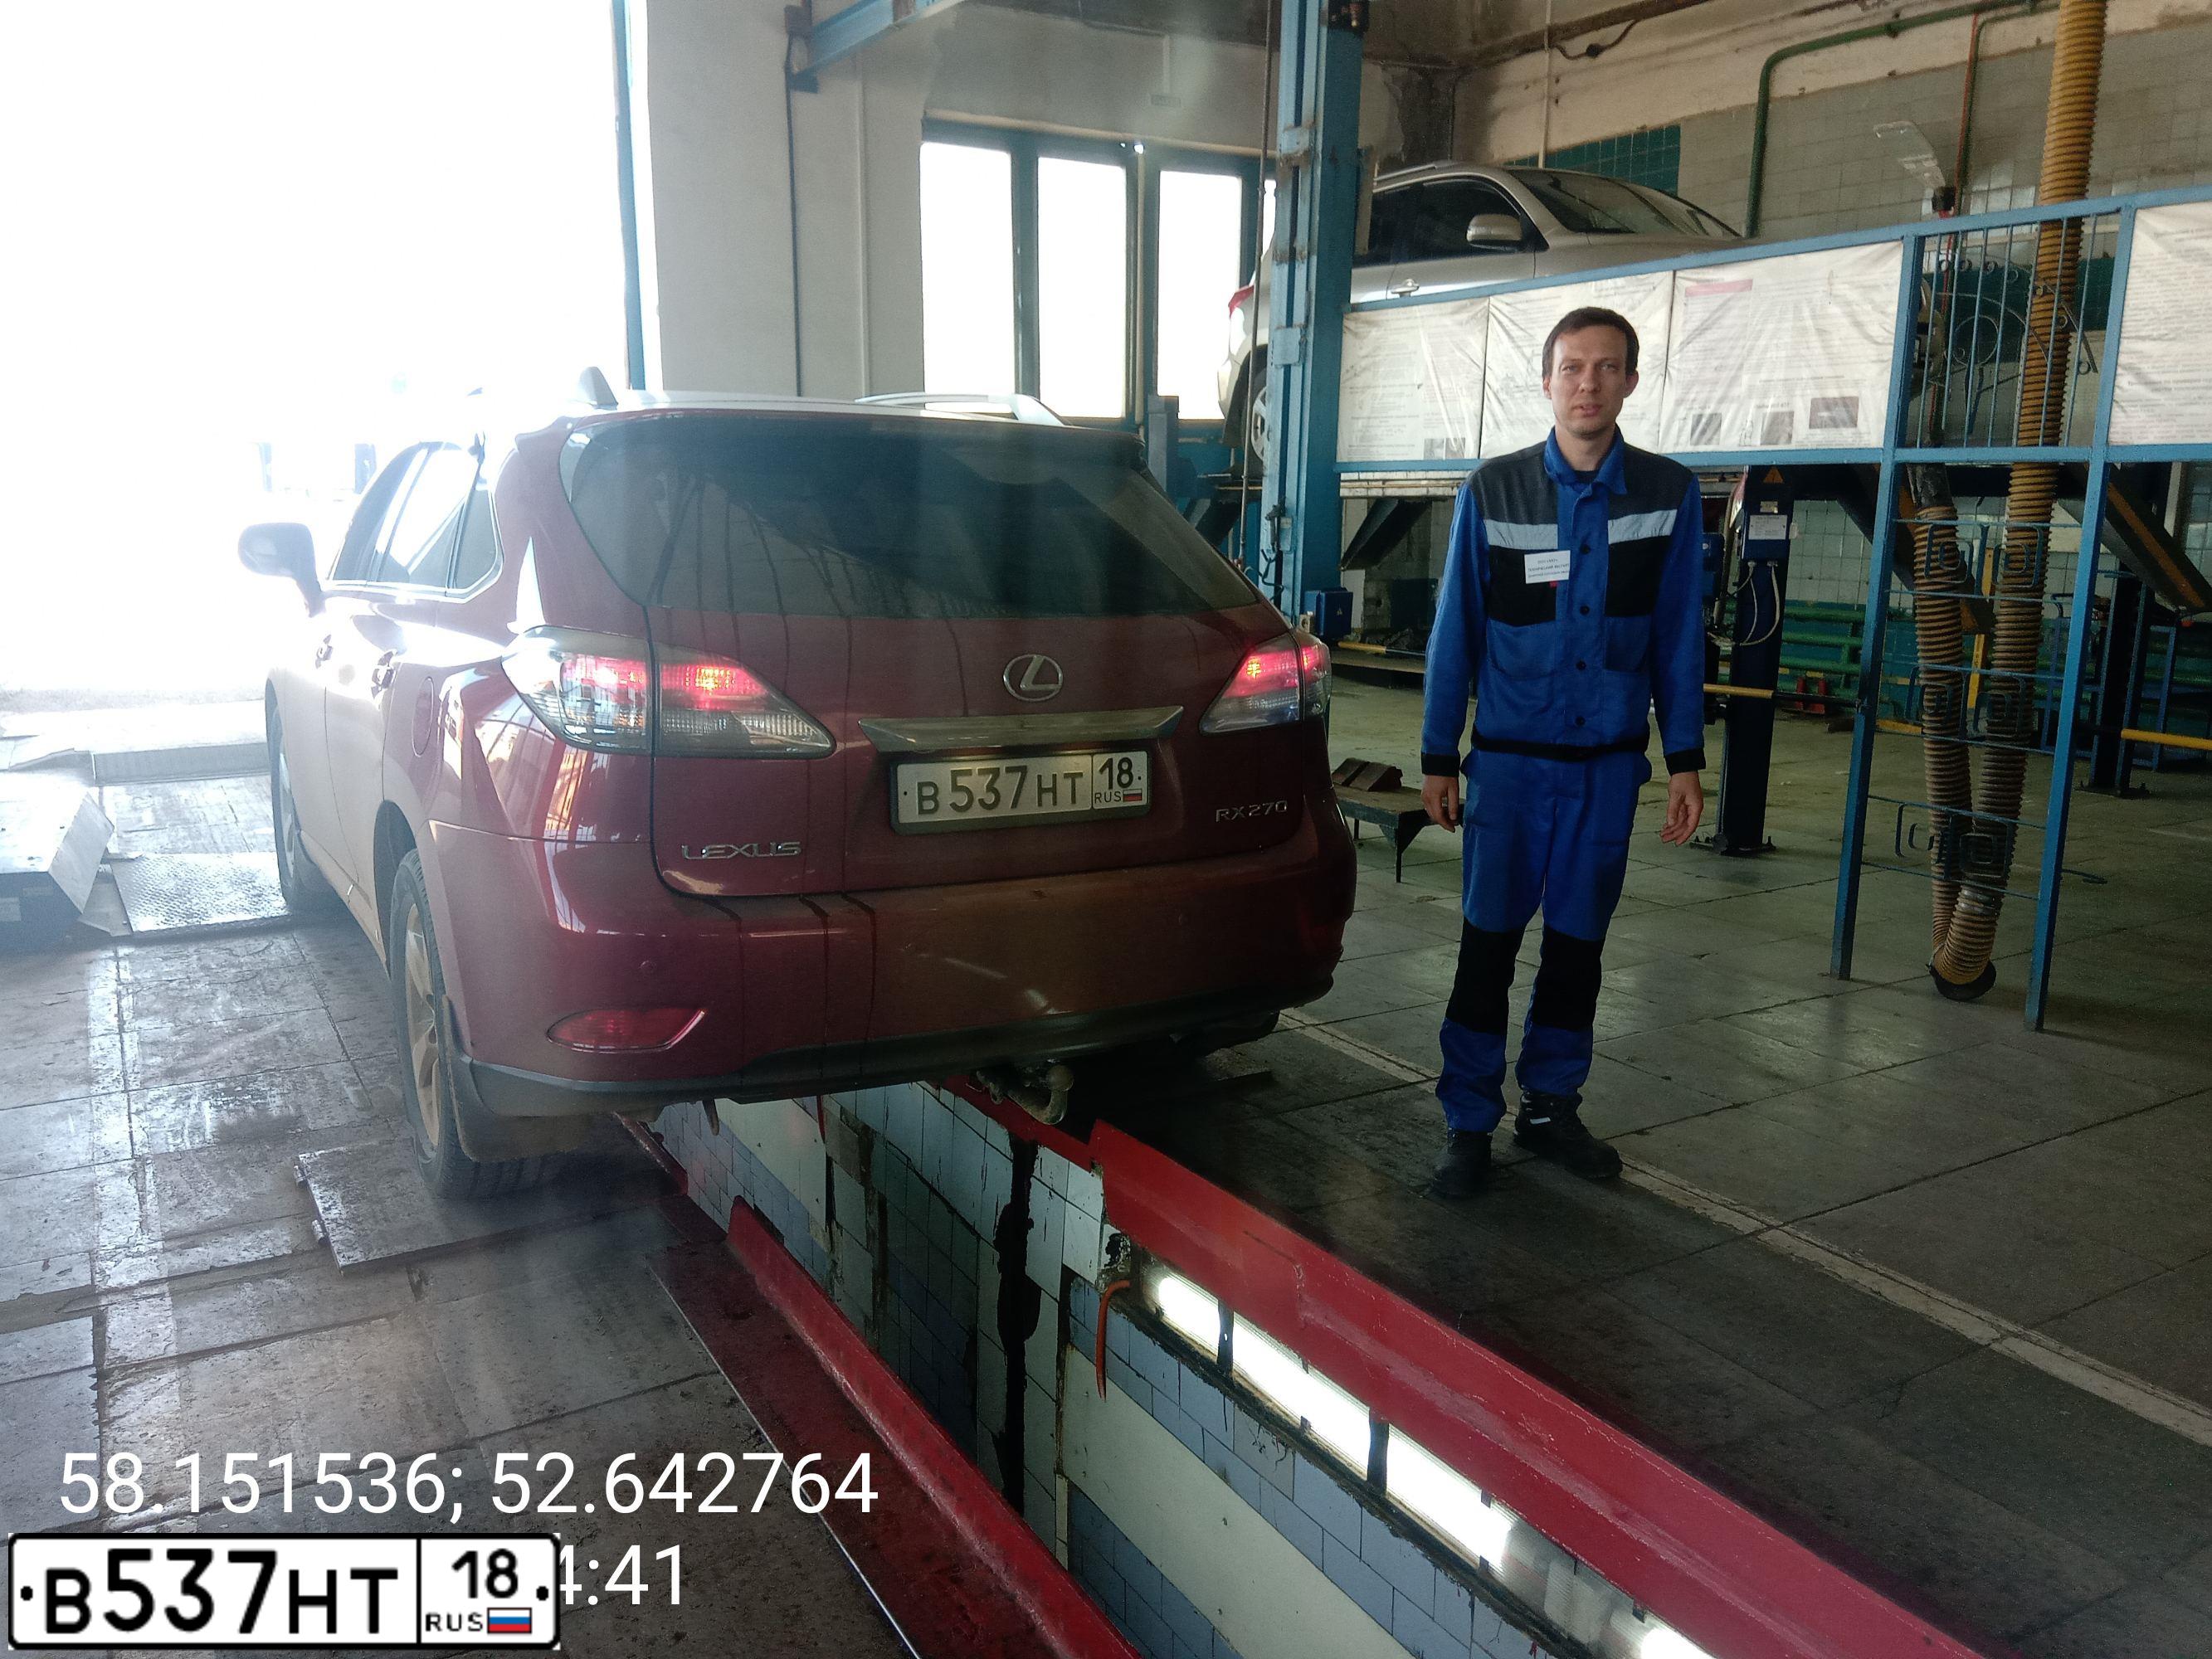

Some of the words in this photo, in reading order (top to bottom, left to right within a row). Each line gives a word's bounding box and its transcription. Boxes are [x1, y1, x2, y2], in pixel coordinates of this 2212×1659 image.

[1098, 757, 1135, 790] 18
[1094, 790, 1122, 804] RUS
[680, 840, 802, 860] LEXUS
